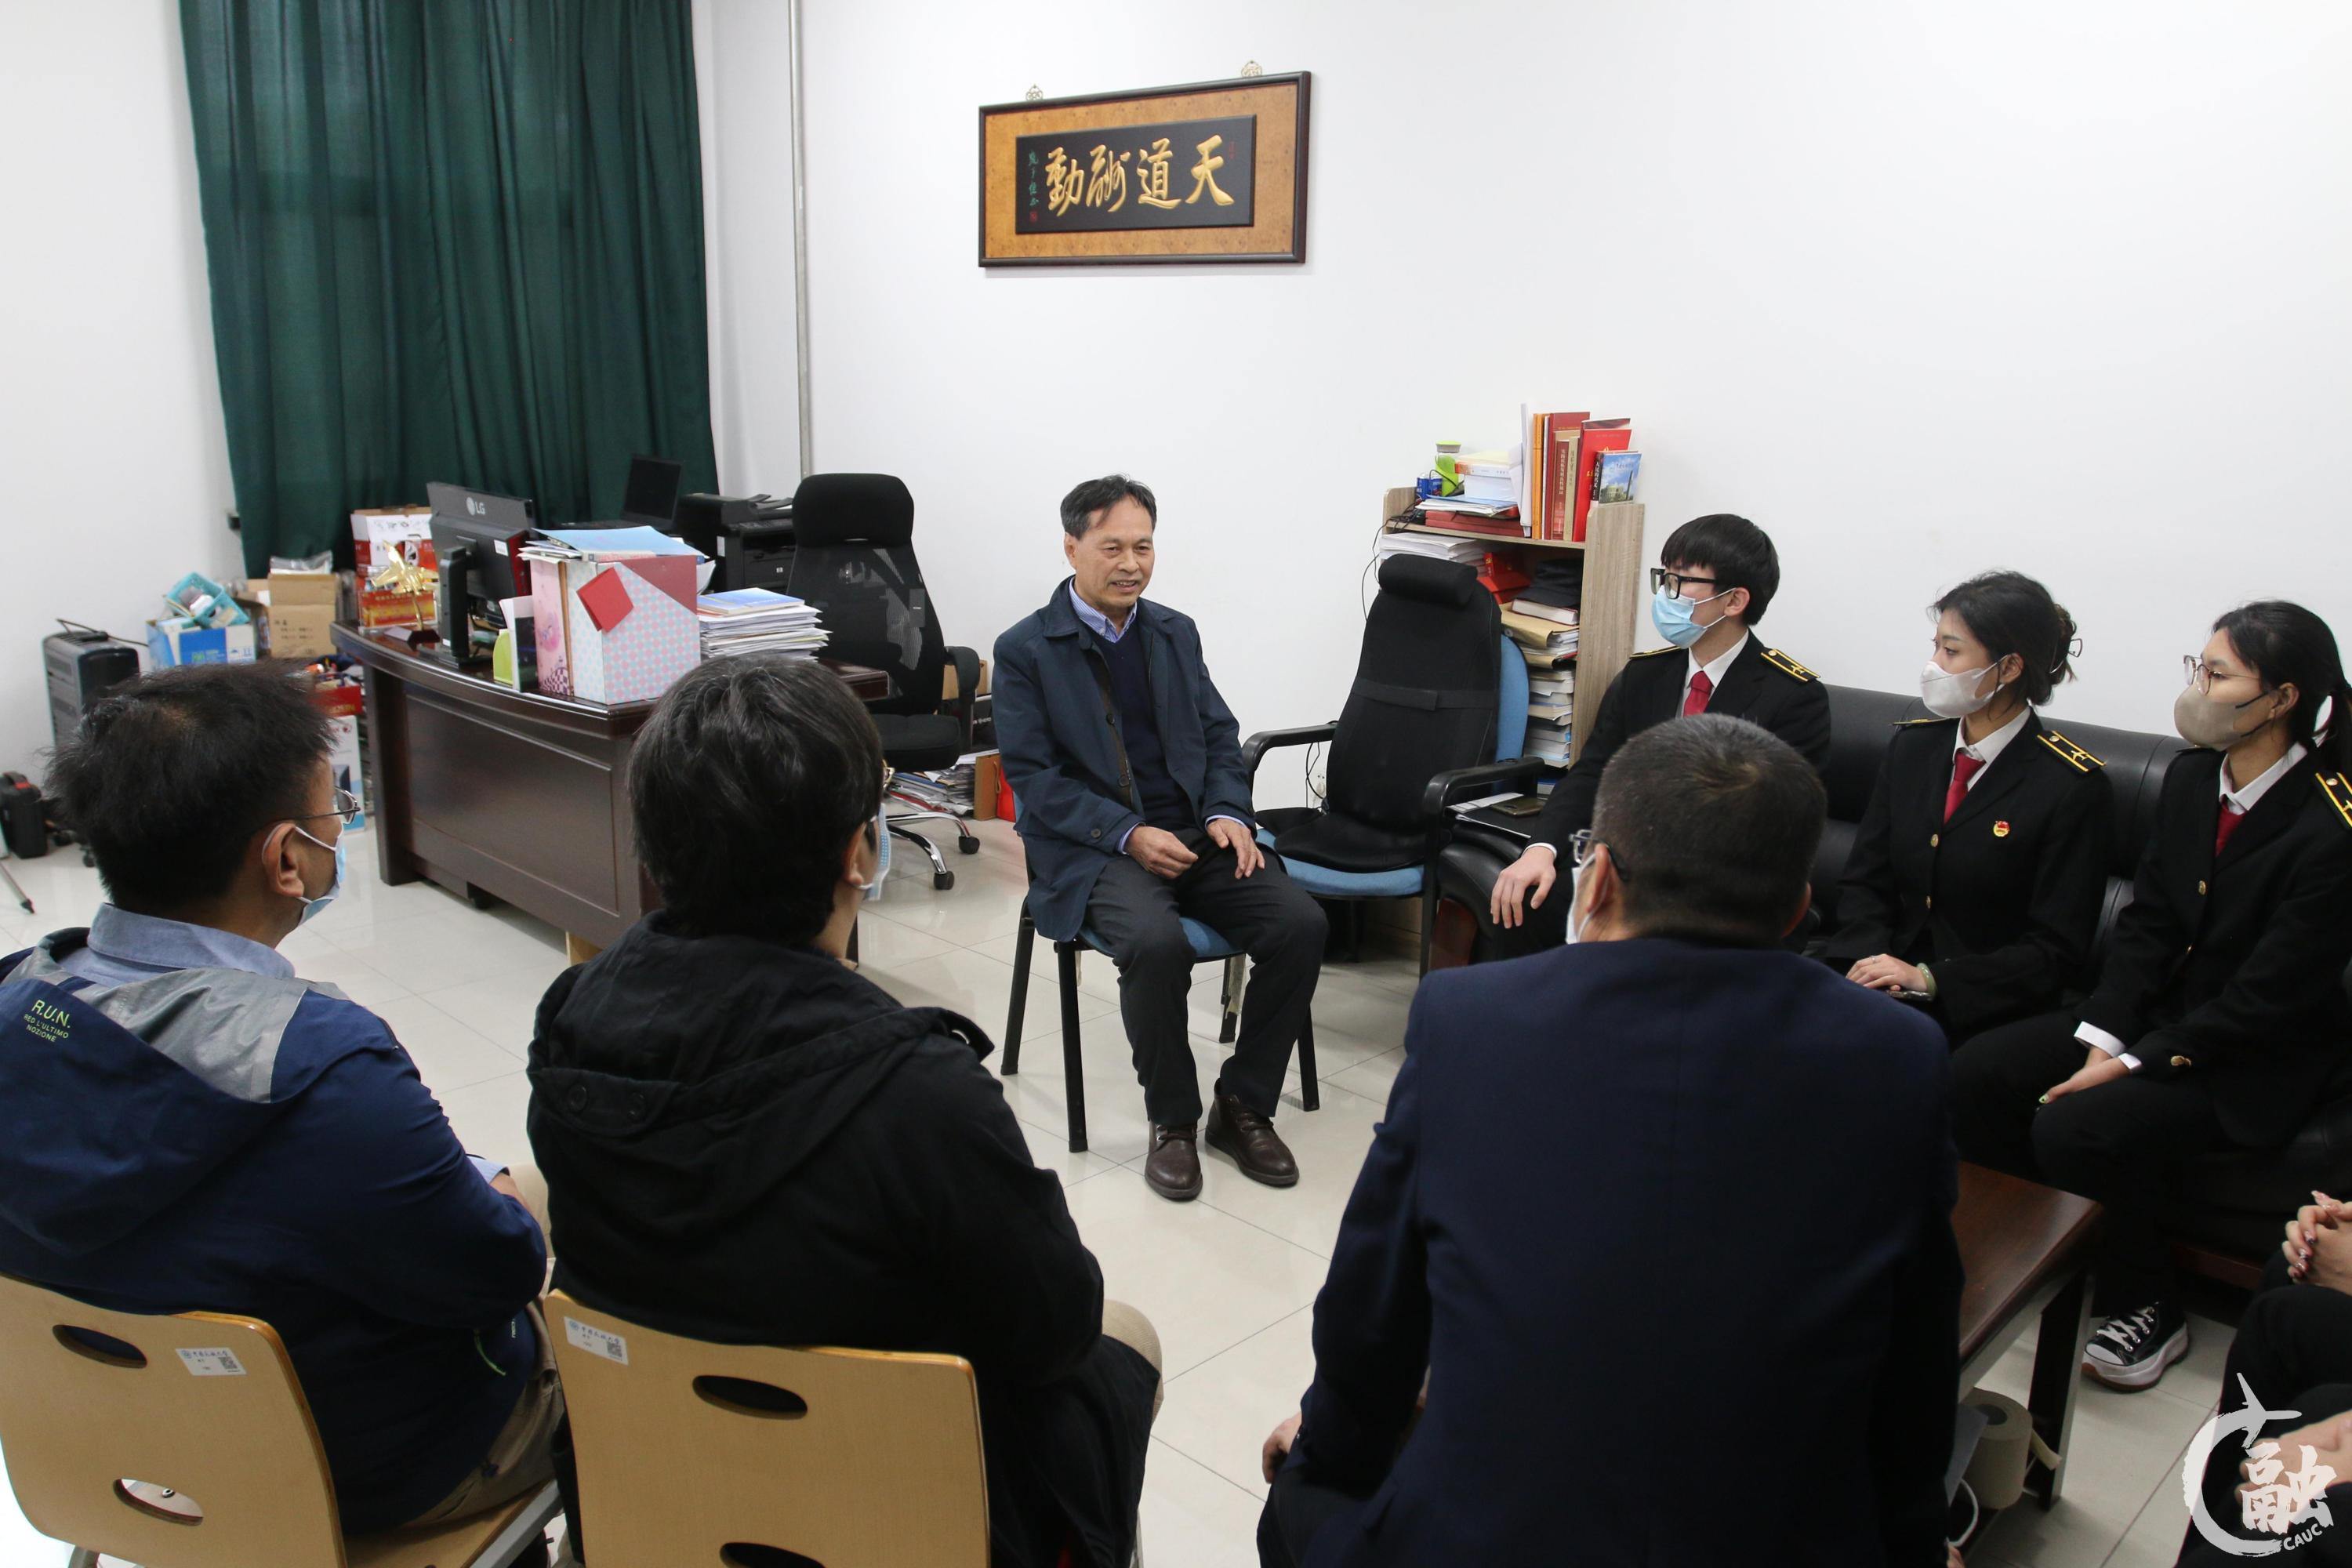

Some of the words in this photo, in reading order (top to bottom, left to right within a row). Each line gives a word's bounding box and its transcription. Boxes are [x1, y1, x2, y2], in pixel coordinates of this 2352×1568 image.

[474, 501, 486, 515] LG
[31, 1000, 70, 1028] R.U.N.
[26, 1024, 56, 1041] NOZIONE
